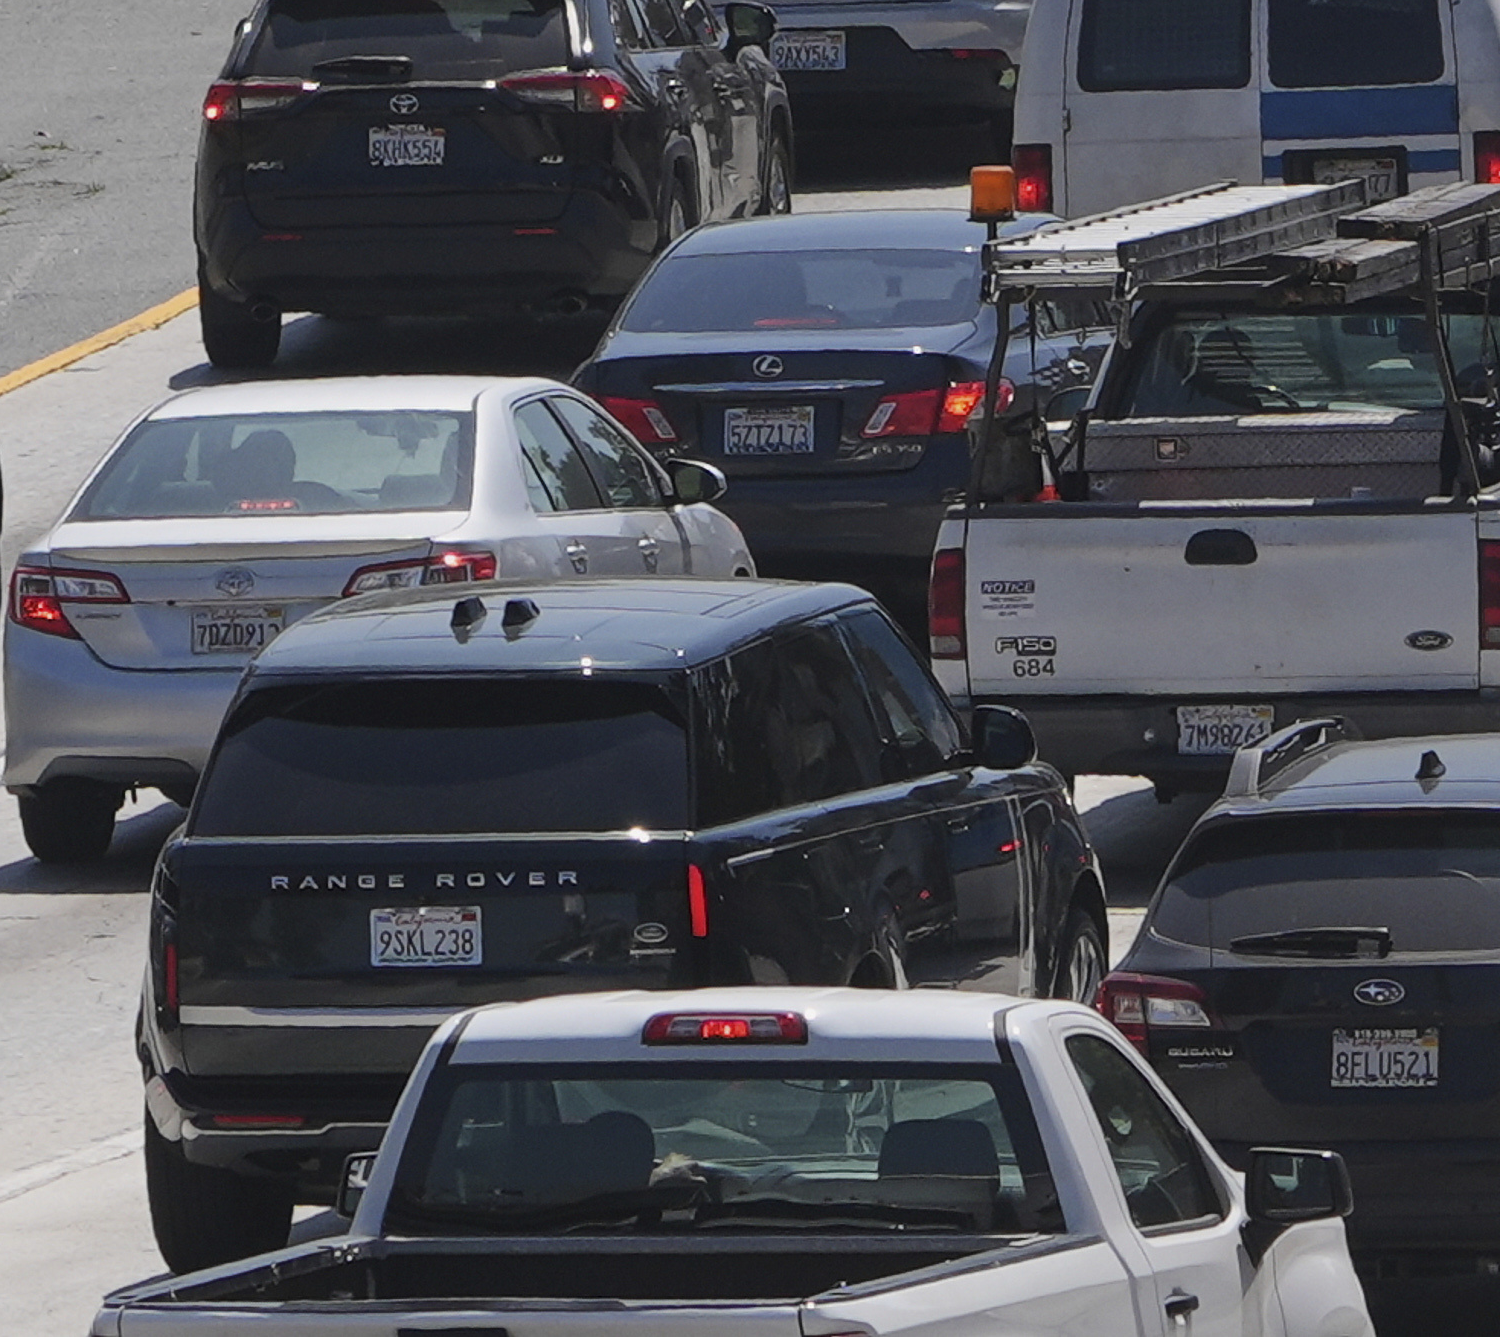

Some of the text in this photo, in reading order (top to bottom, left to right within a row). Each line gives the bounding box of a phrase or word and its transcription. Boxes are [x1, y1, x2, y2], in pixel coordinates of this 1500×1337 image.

[371, 138, 443, 162] 8KHK554
[730, 423, 808, 449] 5ZTZ173
[981, 580, 1035, 595] NOTICE
[1012, 658, 1058, 678] 684
[270, 870, 580, 891] RANGE ROVER
[393, 910, 457, 931] California
[378, 929, 474, 957] 9SKL238
[1167, 1046, 1234, 1058] SUBARU
[1336, 1051, 1434, 1079] 8FLU521
